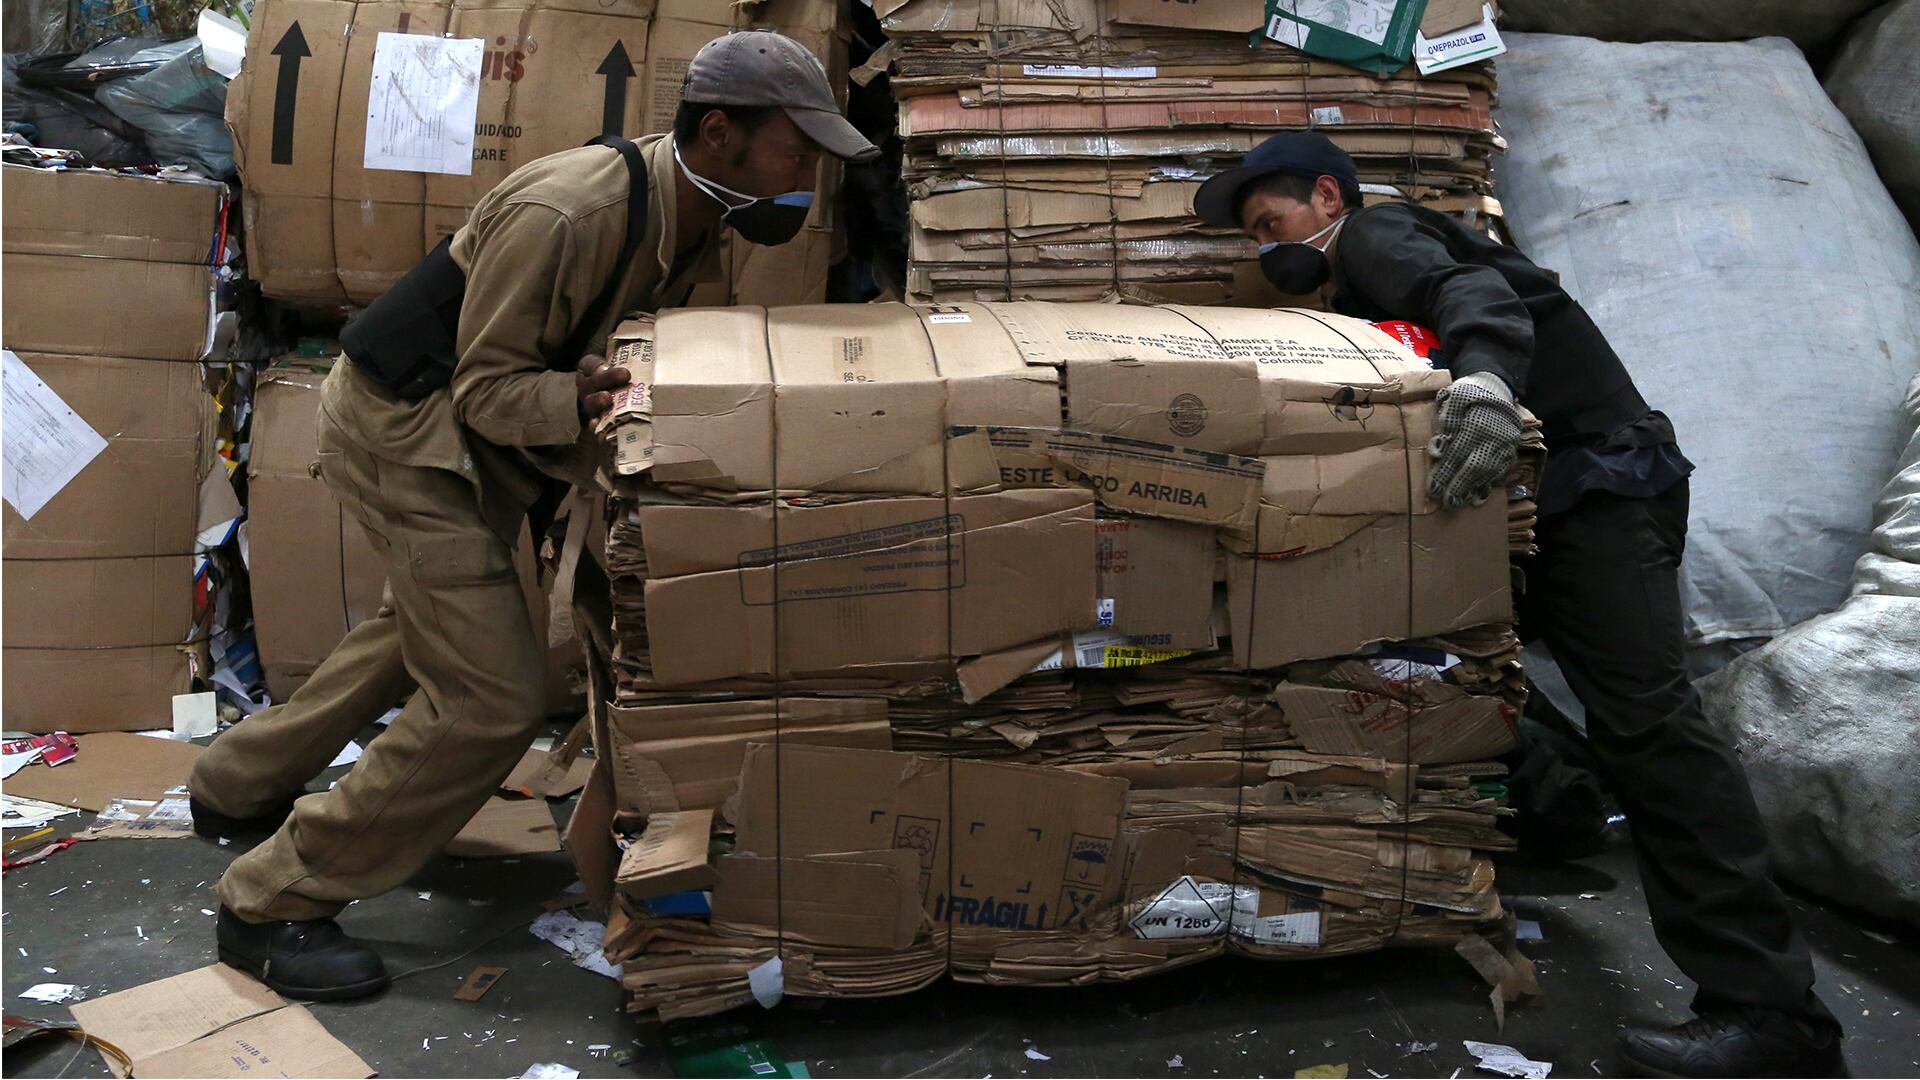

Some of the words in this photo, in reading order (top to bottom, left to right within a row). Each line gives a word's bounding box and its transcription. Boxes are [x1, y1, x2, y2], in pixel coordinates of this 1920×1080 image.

[1427, 37, 1471, 55] OMEPRAZOL
[474, 123, 522, 139] UIDADO
[1065, 330, 1112, 338] Centro
[1259, 357, 1324, 365] Colombia
[630, 382, 645, 406] EGGS
[1000, 467, 1054, 485] ESTE
[1128, 480, 1208, 509] ARRIBA
